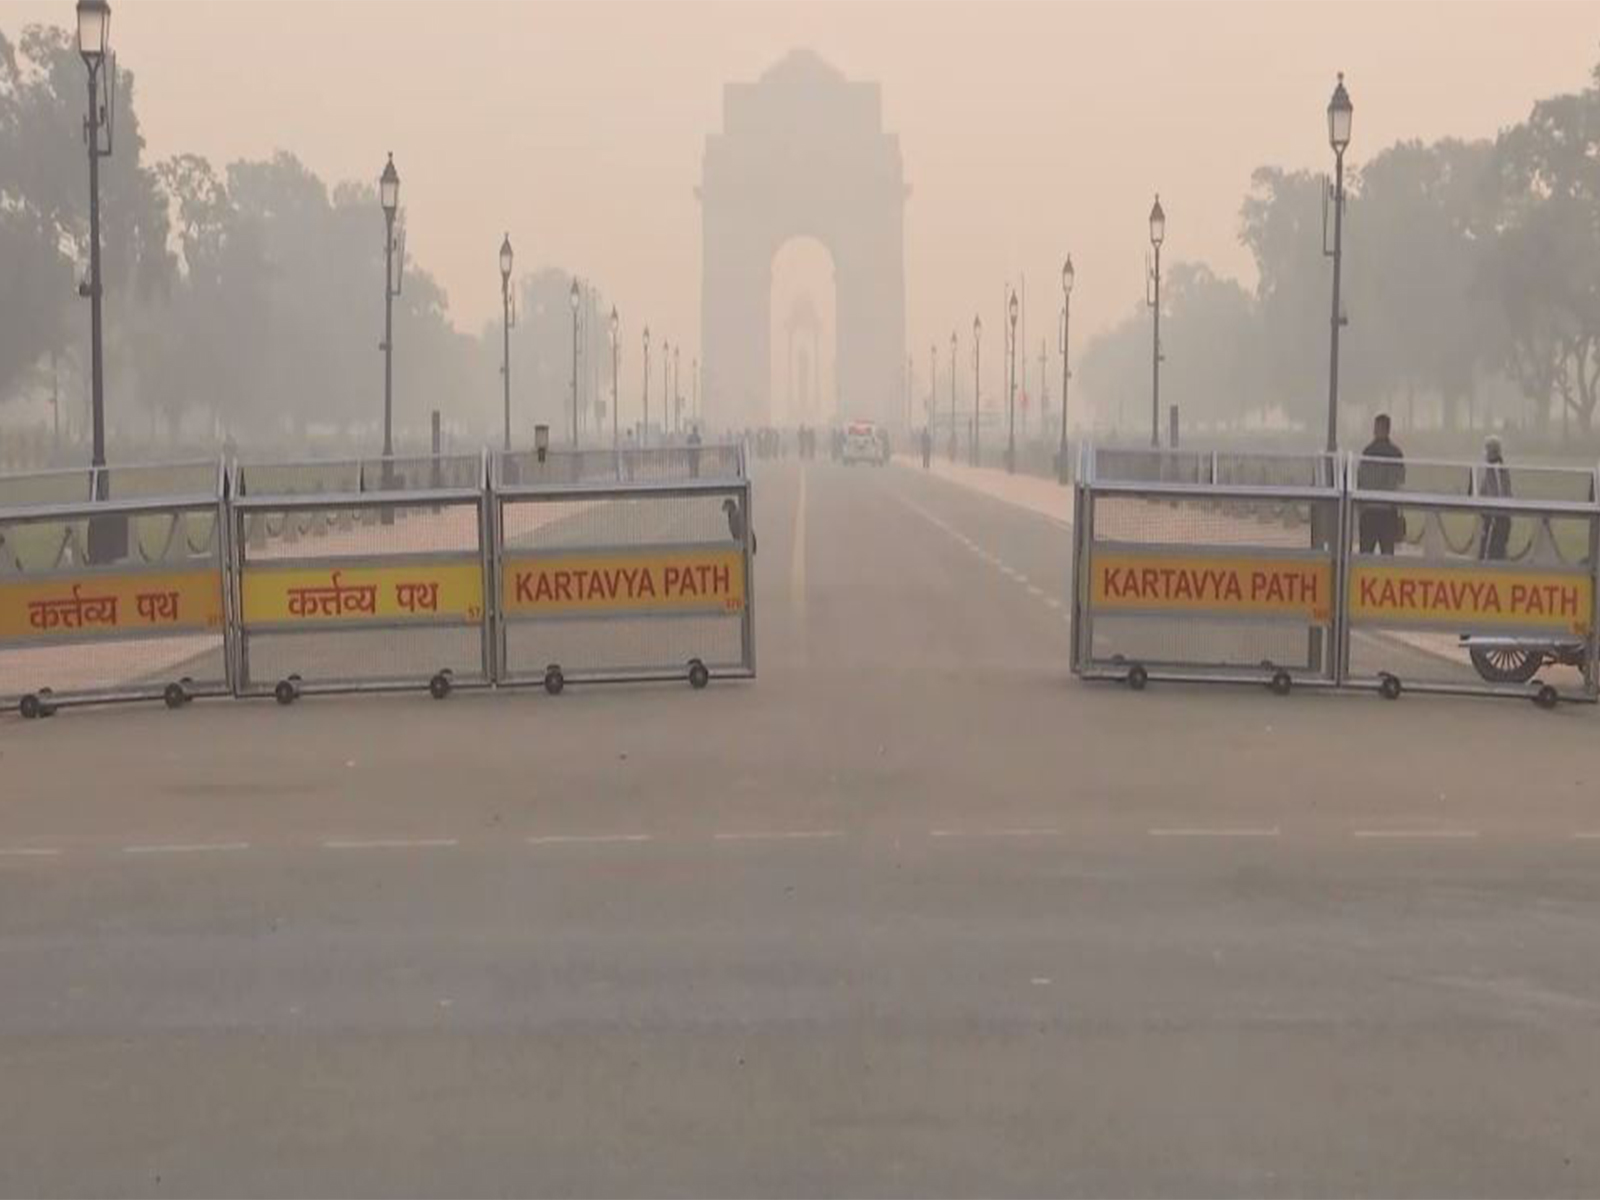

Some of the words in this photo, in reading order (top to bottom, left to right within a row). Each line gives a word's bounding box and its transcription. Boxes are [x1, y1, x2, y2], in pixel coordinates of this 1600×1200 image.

[396, 582, 439, 612] पथ
[515, 567, 656, 602] KARTAVYA
[663, 563, 730, 597] PATH
[1103, 567, 1242, 600] KARTAVYA
[1251, 573, 1318, 602] PATH
[1360, 576, 1502, 612] KARTAVYA
[1511, 584, 1579, 617] PATH
[136, 592, 180, 622] पथ
